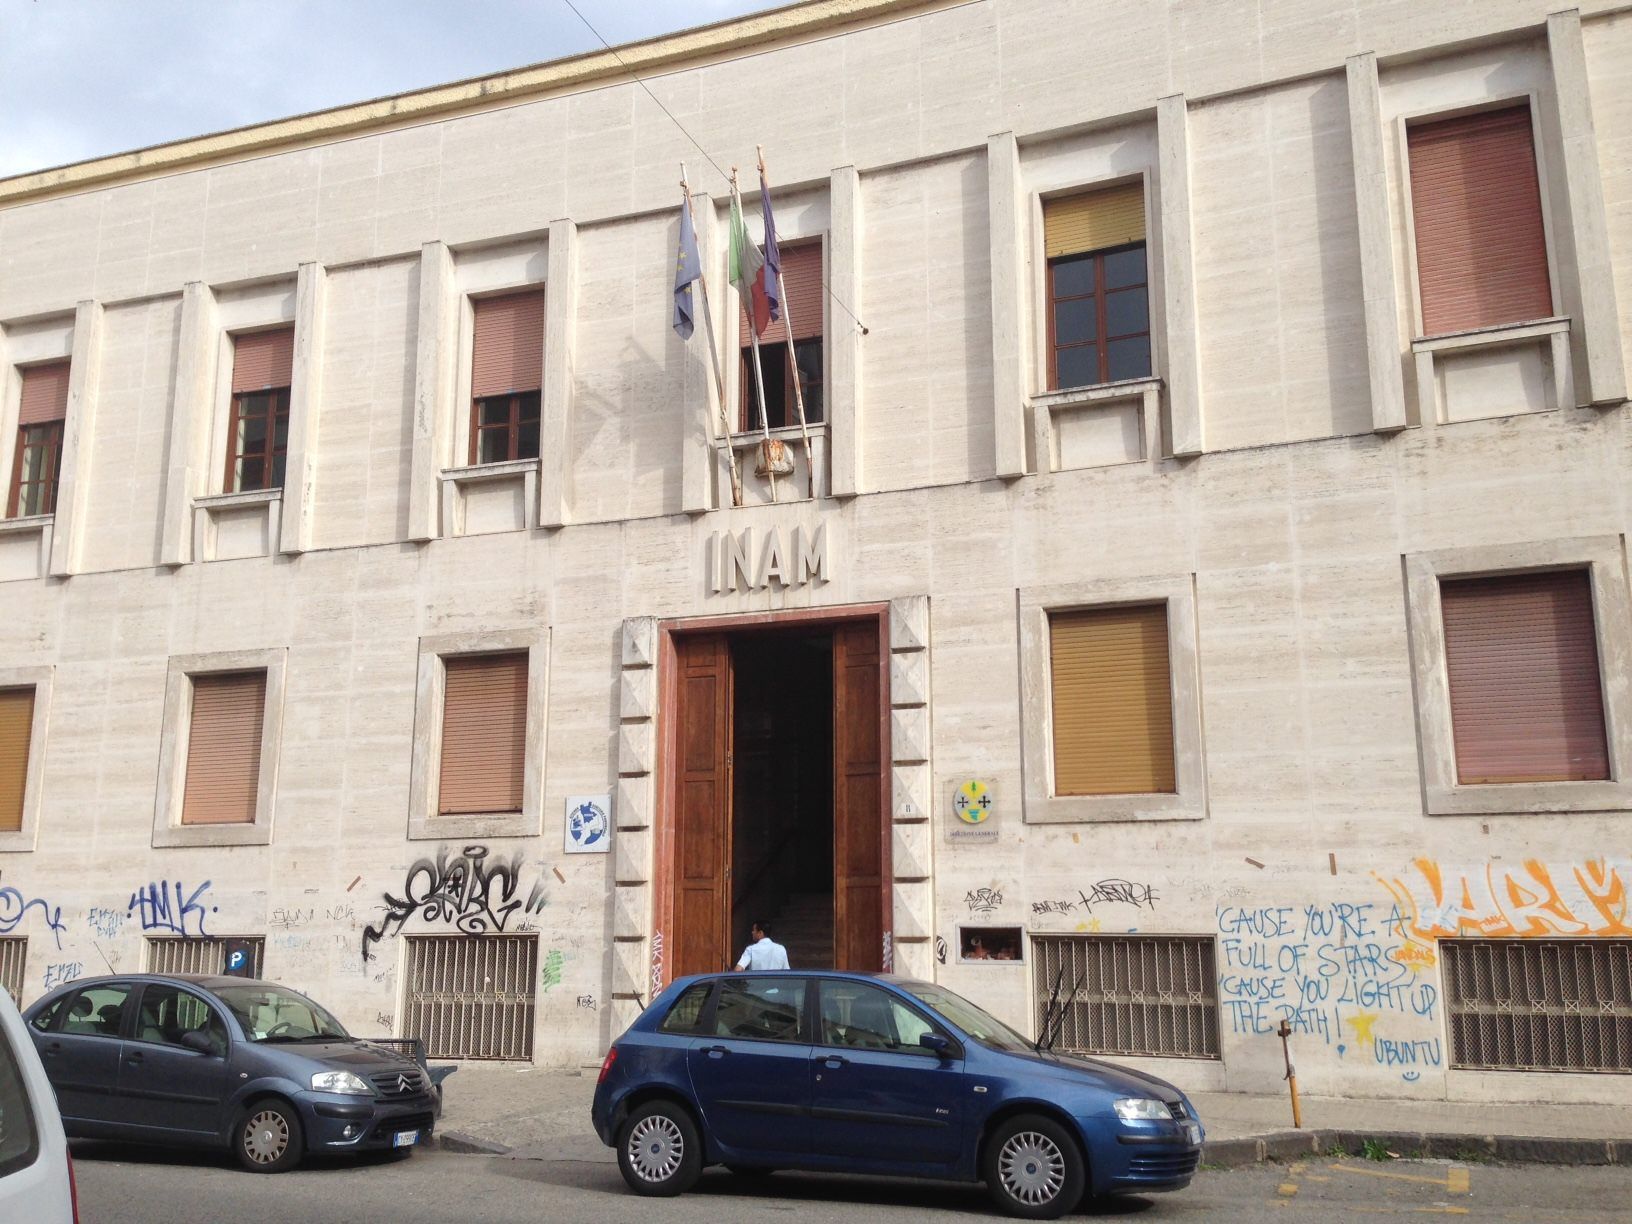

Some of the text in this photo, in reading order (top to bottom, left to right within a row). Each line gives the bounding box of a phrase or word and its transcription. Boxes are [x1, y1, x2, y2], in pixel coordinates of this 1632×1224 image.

[706, 519, 831, 597] INAM
[1215, 902, 1411, 942] 'CAUSE YOU'RE A
[1222, 939, 1272, 970] FULL
[1278, 944, 1308, 976] OF
[1222, 999, 1274, 1034] THE
[1294, 974, 1329, 1011] YOU
[1411, 983, 1437, 1021] UP
[1374, 1034, 1441, 1066] UBUNTU
